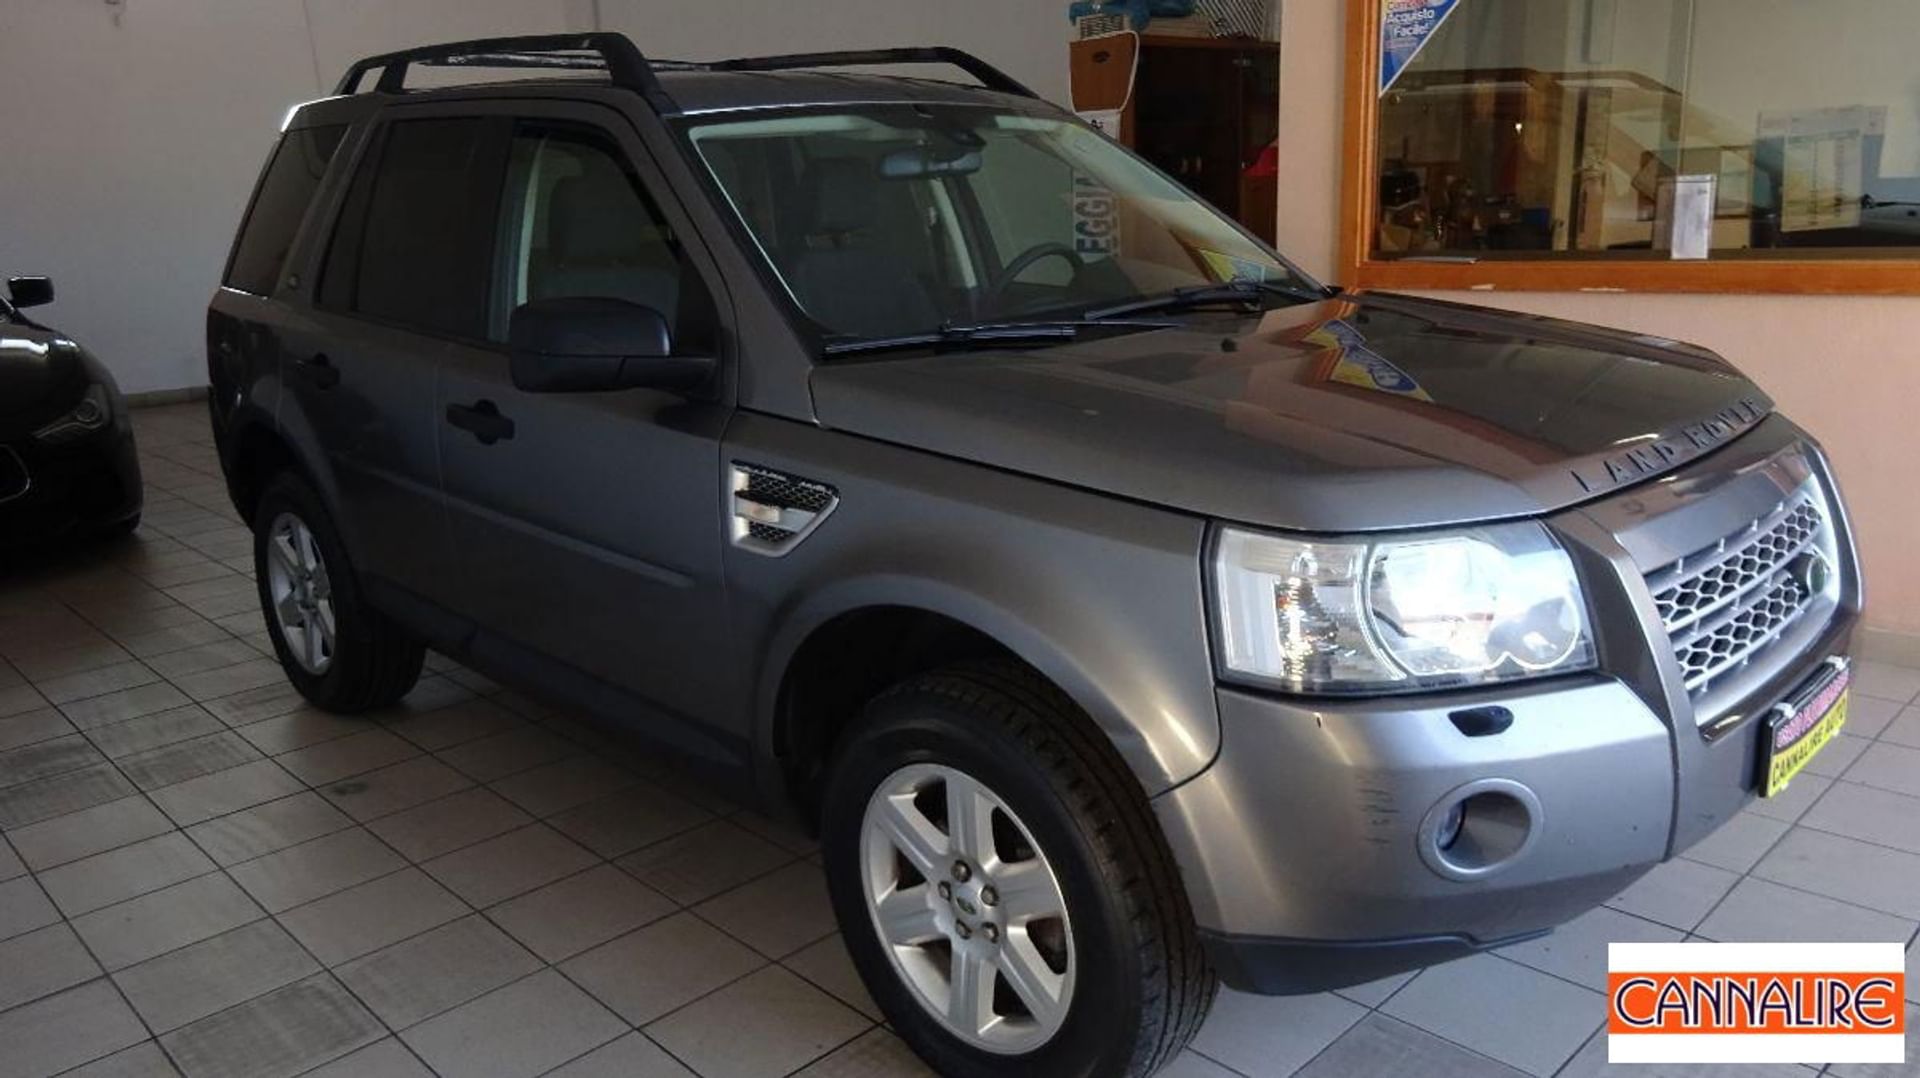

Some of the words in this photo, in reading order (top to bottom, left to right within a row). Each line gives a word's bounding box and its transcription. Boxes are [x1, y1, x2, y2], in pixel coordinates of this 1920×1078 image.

[1571, 442, 1676, 492] LAND
[1681, 399, 1763, 449] ROVER
[1772, 723, 1825, 788] CANNALIRE
